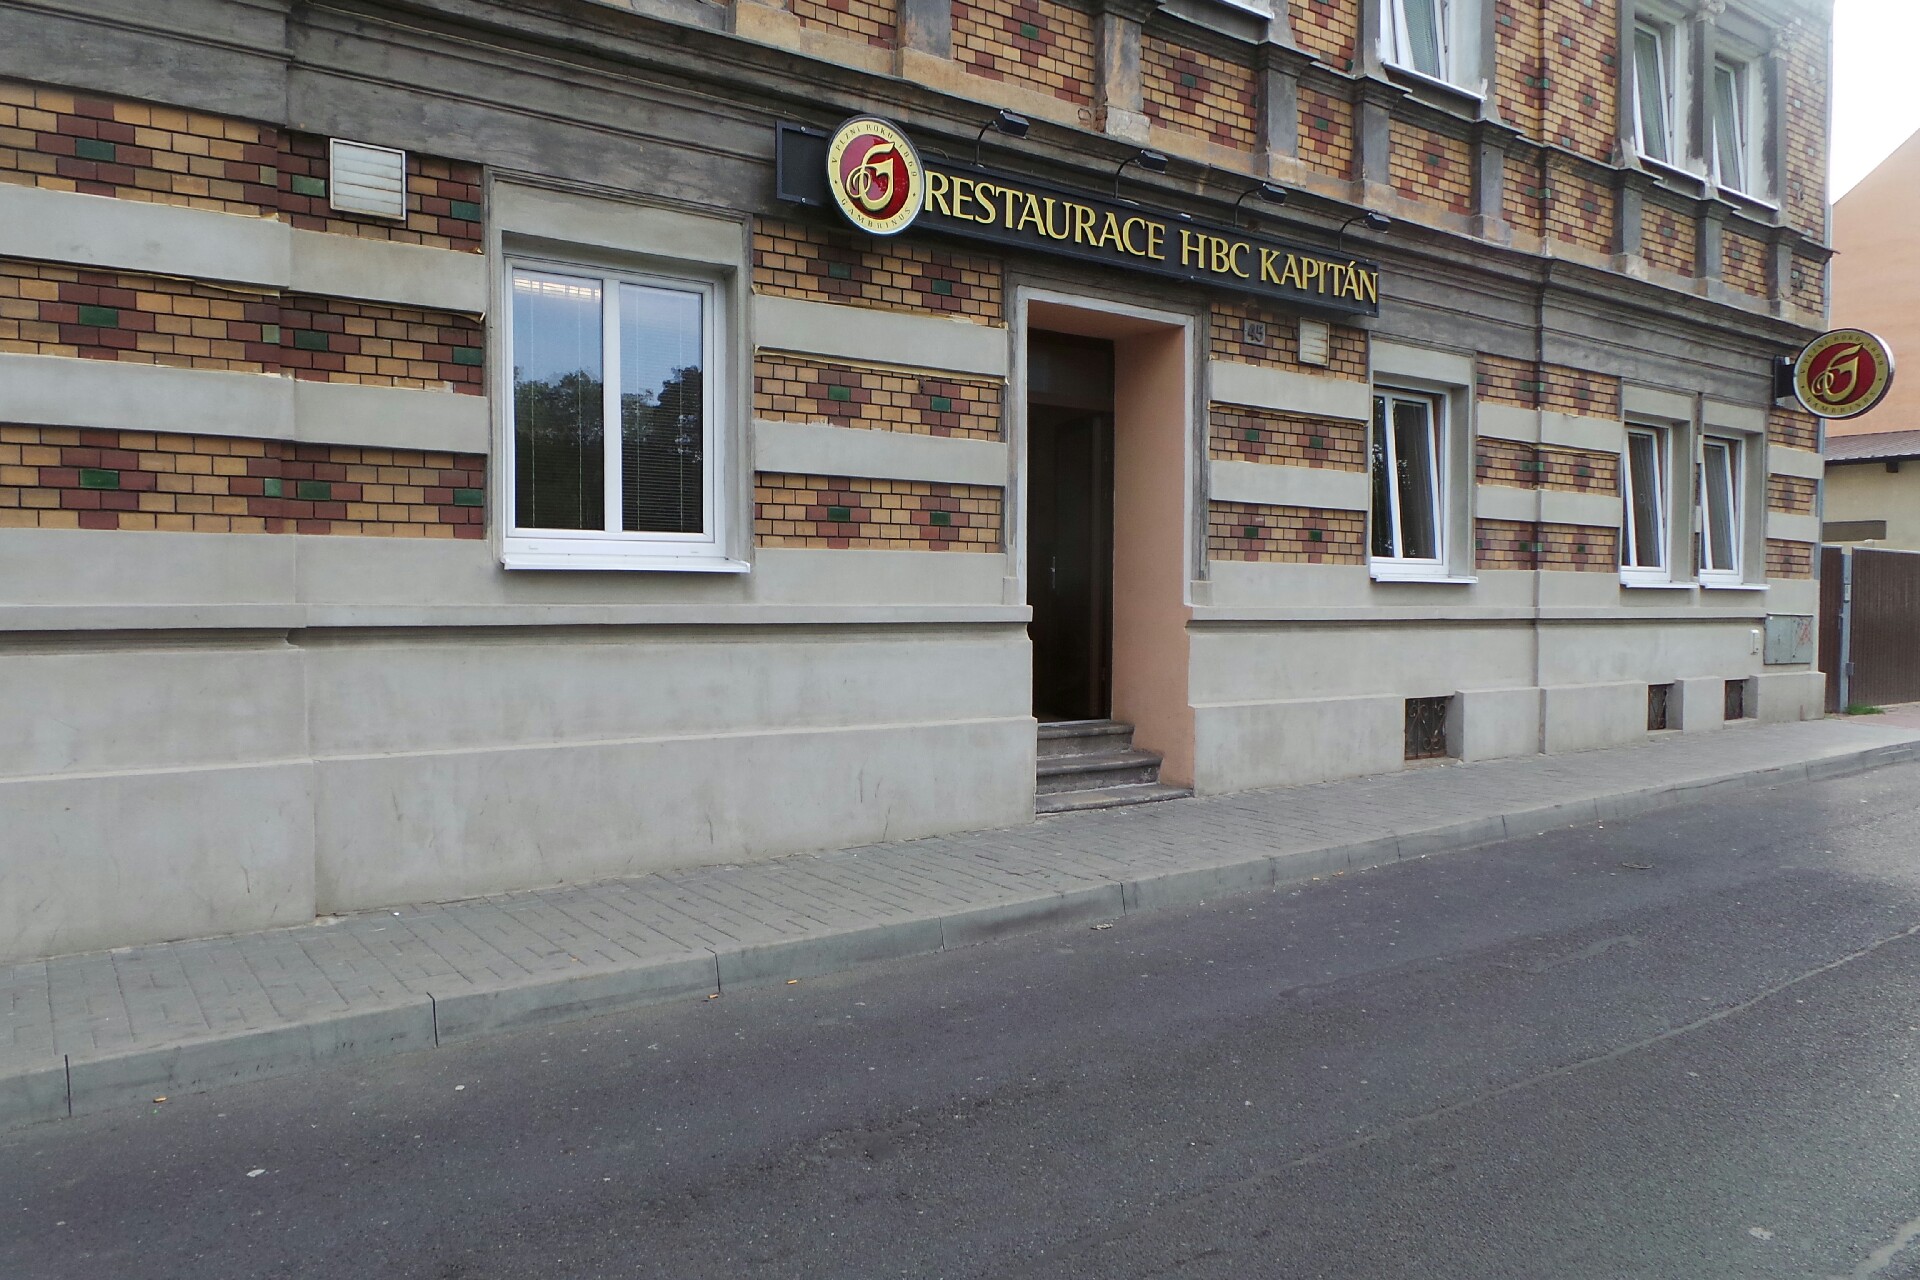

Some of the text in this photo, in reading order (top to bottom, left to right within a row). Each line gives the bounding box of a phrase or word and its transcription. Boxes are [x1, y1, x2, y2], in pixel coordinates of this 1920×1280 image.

[866, 124, 894, 139] ROKU
[840, 197, 912, 229] GAMBRINUS
[924, 170, 1378, 304] RESTAURACE HBC KAPITÁN
[1248, 323, 1264, 342] 45
